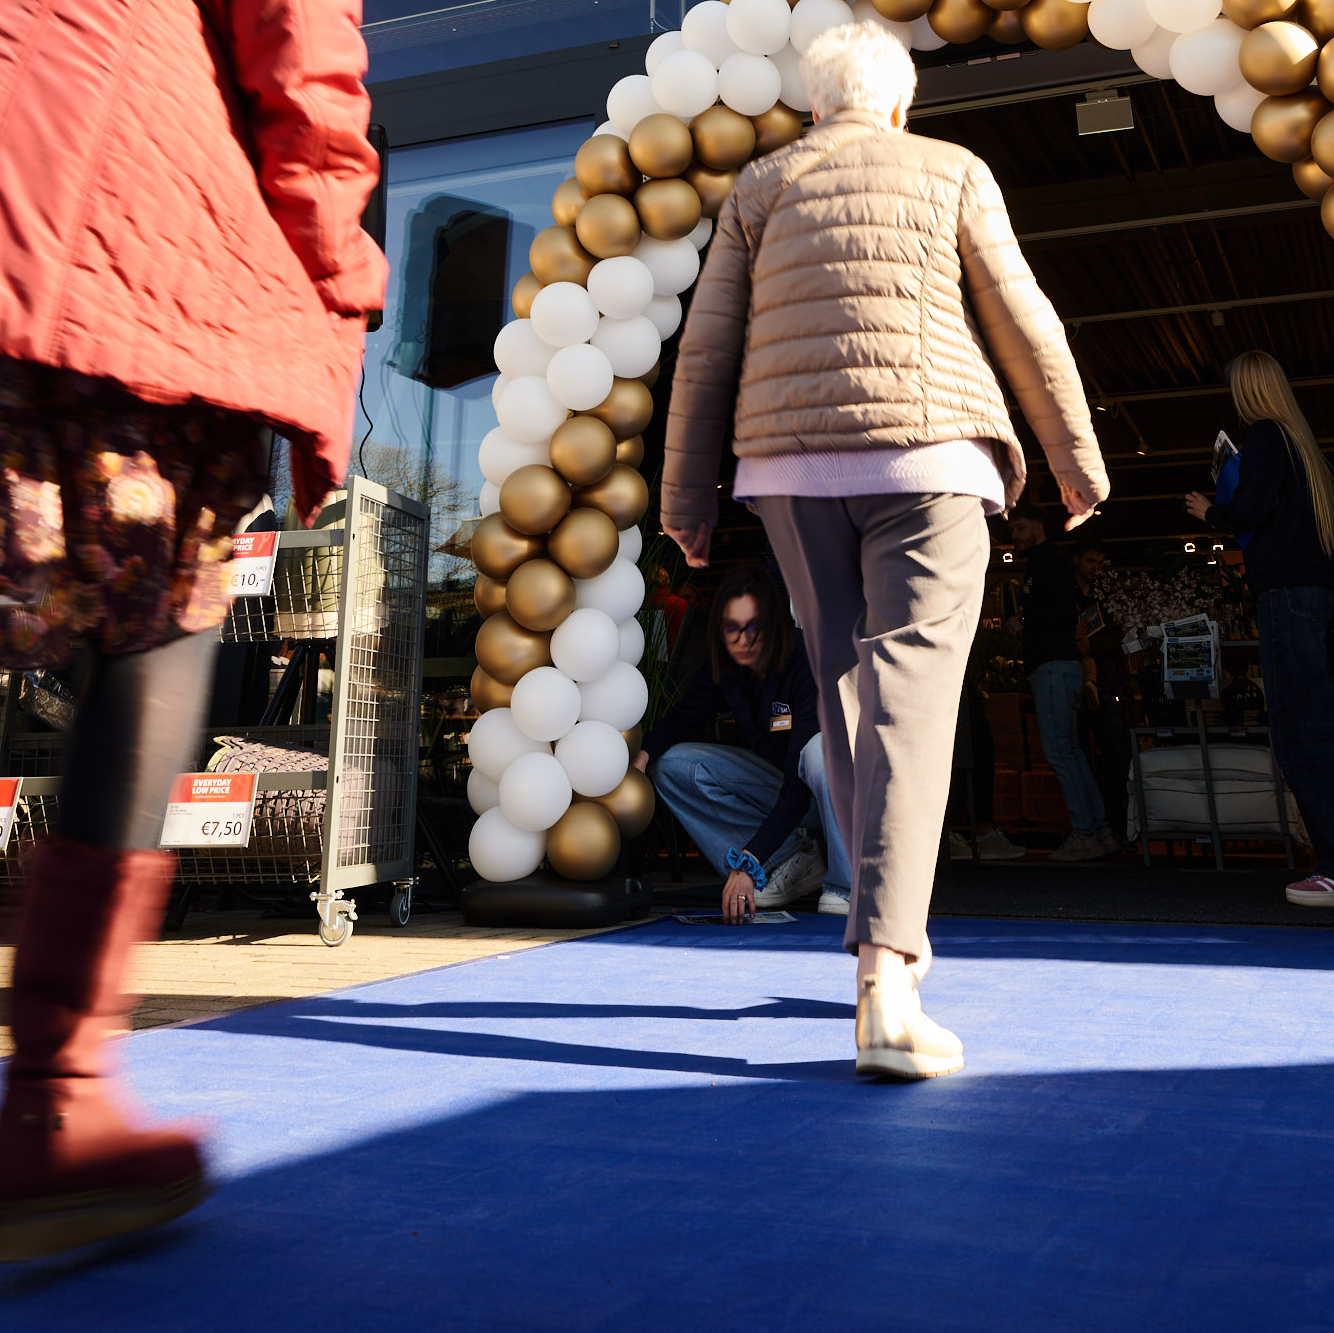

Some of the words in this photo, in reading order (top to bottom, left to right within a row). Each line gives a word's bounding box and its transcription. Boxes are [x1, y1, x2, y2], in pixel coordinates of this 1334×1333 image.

[232, 537, 255, 545] RYDAY
[193, 778, 232, 787] EVERYDAY
[192, 786, 207, 795] LOW
[209, 786, 230, 794] PRICE
[201, 821, 242, 837] €7,50
